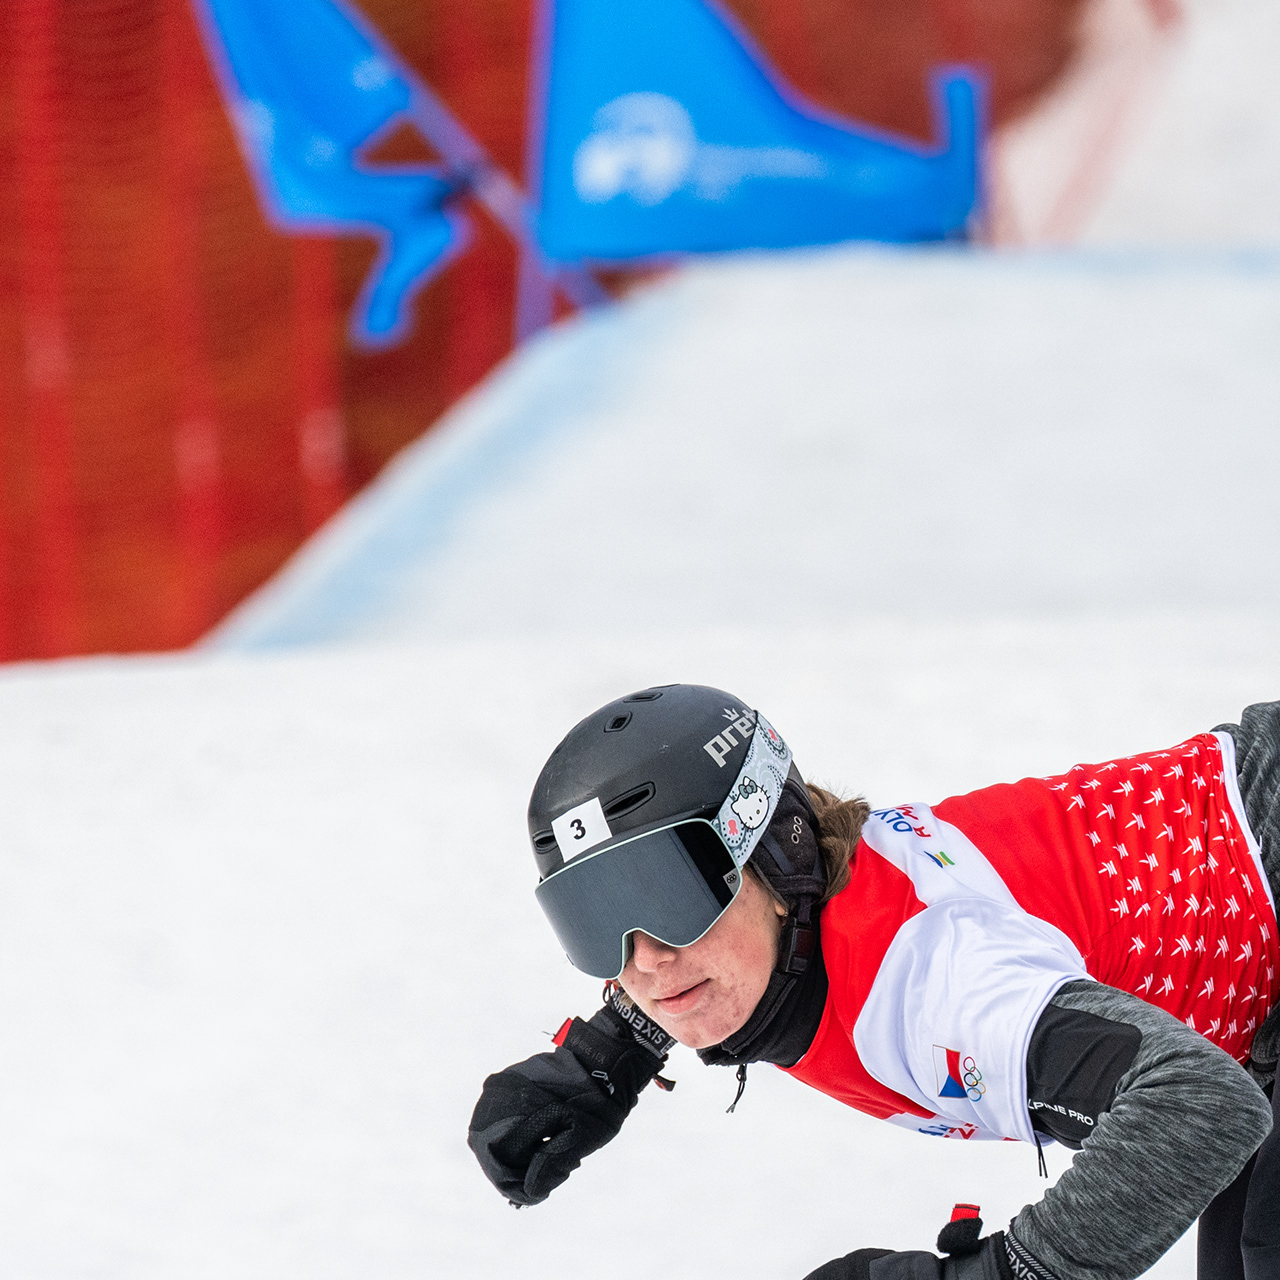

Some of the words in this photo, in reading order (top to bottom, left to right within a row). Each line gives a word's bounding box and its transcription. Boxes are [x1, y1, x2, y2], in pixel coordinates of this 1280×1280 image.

[703, 709, 757, 768] pret
[570, 818, 586, 840] 3
[1028, 1099, 1067, 1115] LPINE
[1068, 1109, 1094, 1126] PRO
